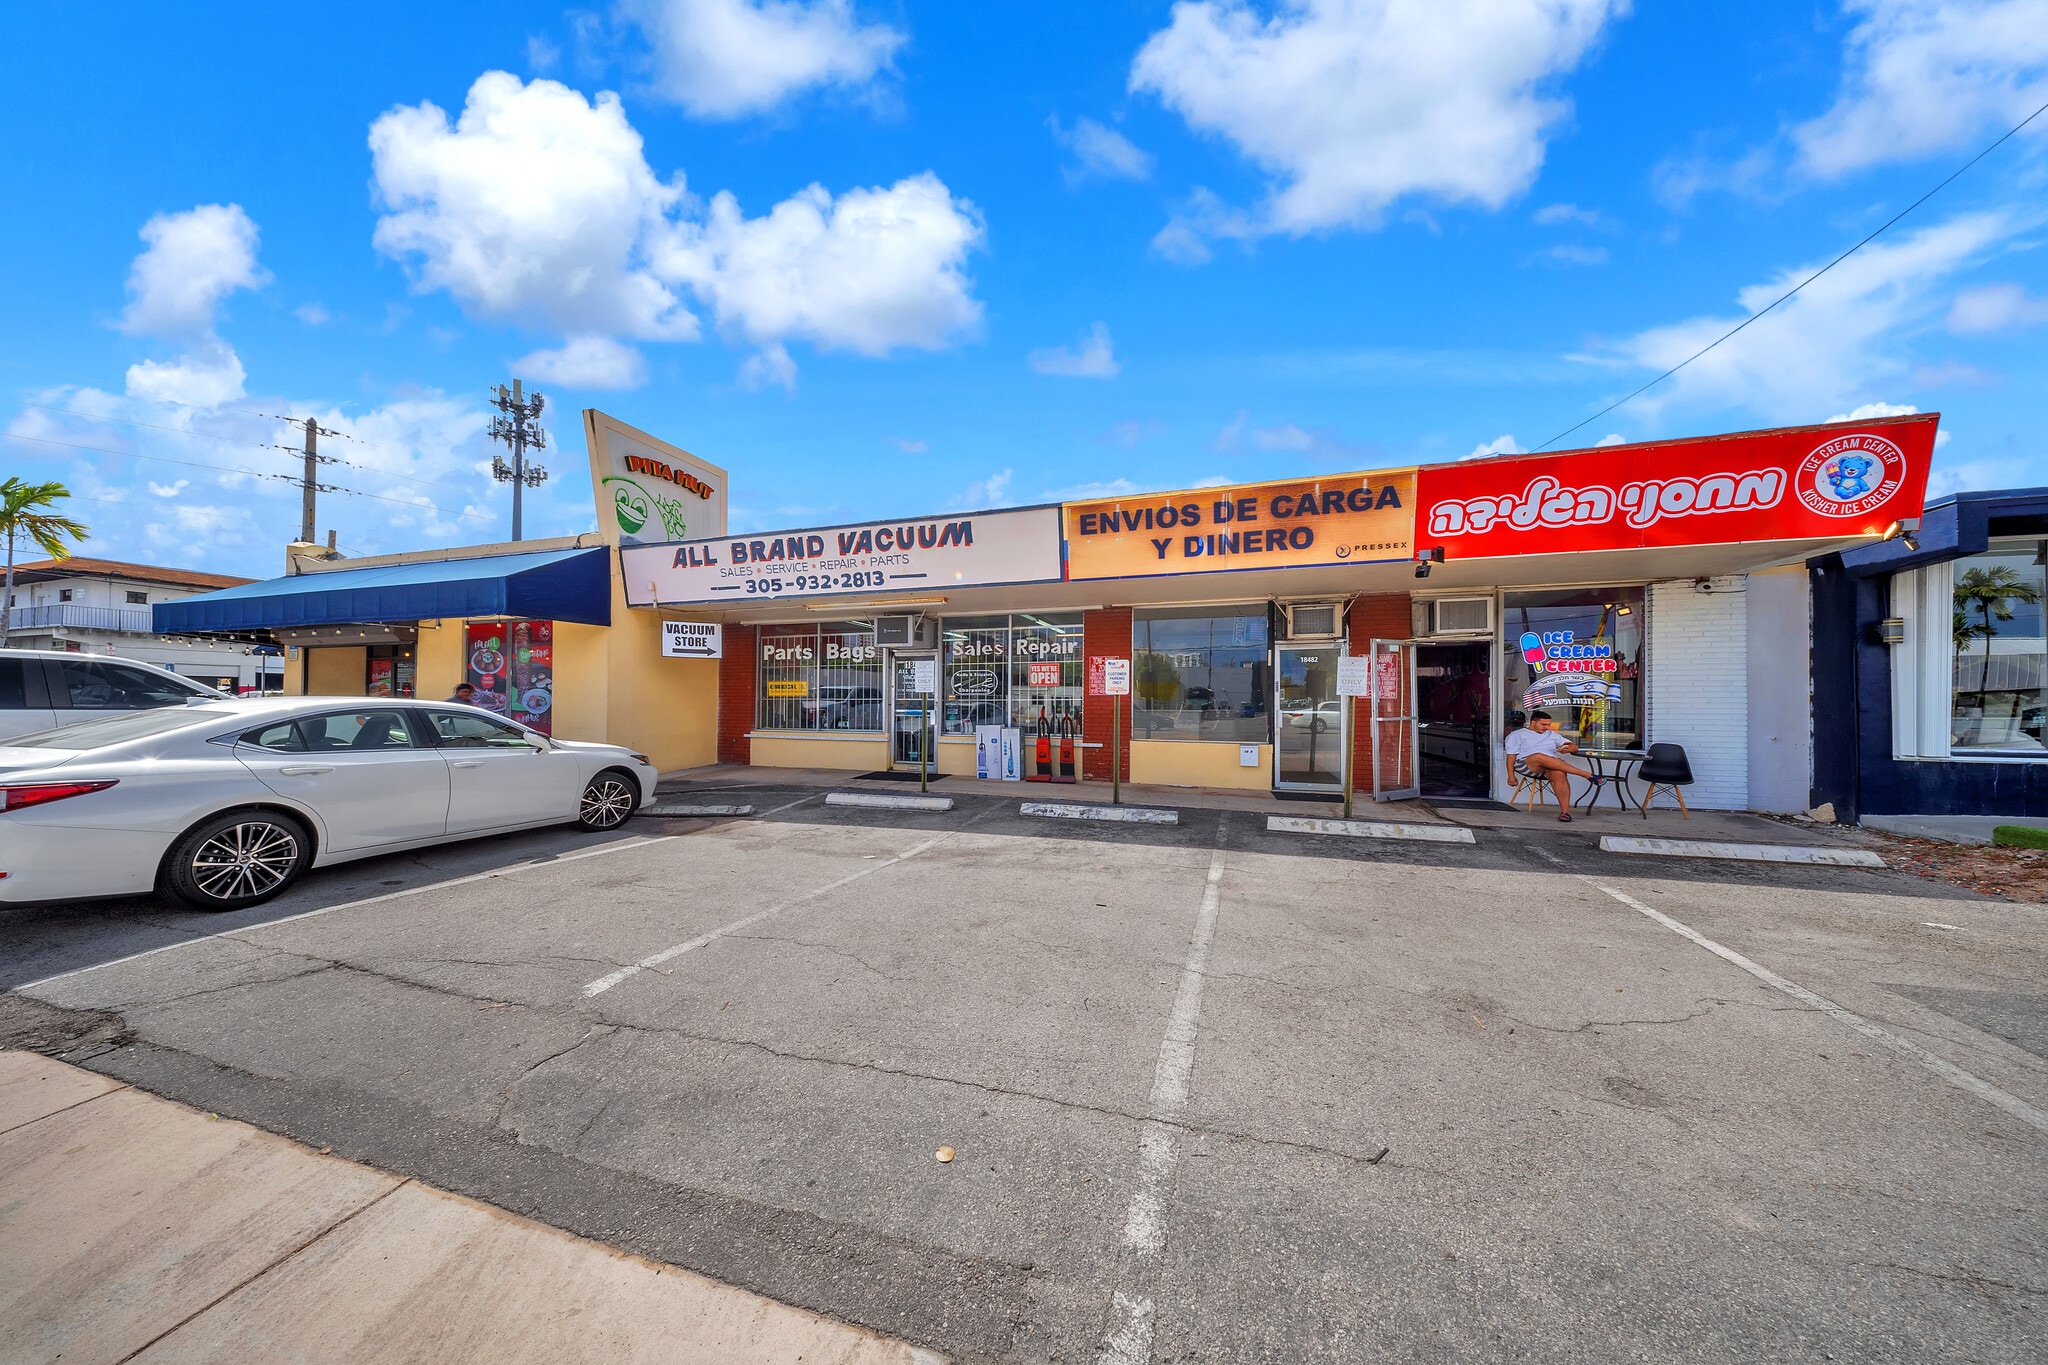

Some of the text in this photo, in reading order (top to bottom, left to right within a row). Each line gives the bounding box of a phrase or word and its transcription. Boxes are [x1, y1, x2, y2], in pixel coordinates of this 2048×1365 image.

[1804, 438, 1899, 472] ICE CREAM CENTER
[624, 455, 715, 499] PITA HUT
[1618, 469, 1783, 527] מחסני
[1801, 480, 1899, 514] KOSHER ICE CREAM
[1080, 485, 1402, 536] ENVIOS DE CARGA
[672, 521, 974, 568] ALL BRAND VACUUM
[1151, 526, 1315, 560] Y DINERO
[1354, 541, 1408, 551] PRESSEX
[719, 554, 910, 578] SALES SERVICE REPAIR PARTS
[665, 623, 716, 636] VACUUM
[1544, 631, 1574, 644] ICE
[674, 636, 708, 647] STORE
[952, 638, 1079, 659] Sales Repair
[1548, 645, 1611, 658] CREAM
[763, 643, 876, 663] Parts Bags
[1041, 664, 1058, 672] WE'RE
[1546, 659, 1617, 672] CENTER
[1031, 672, 1059, 685] OPEN
[1063, 750, 1071, 758] 2
